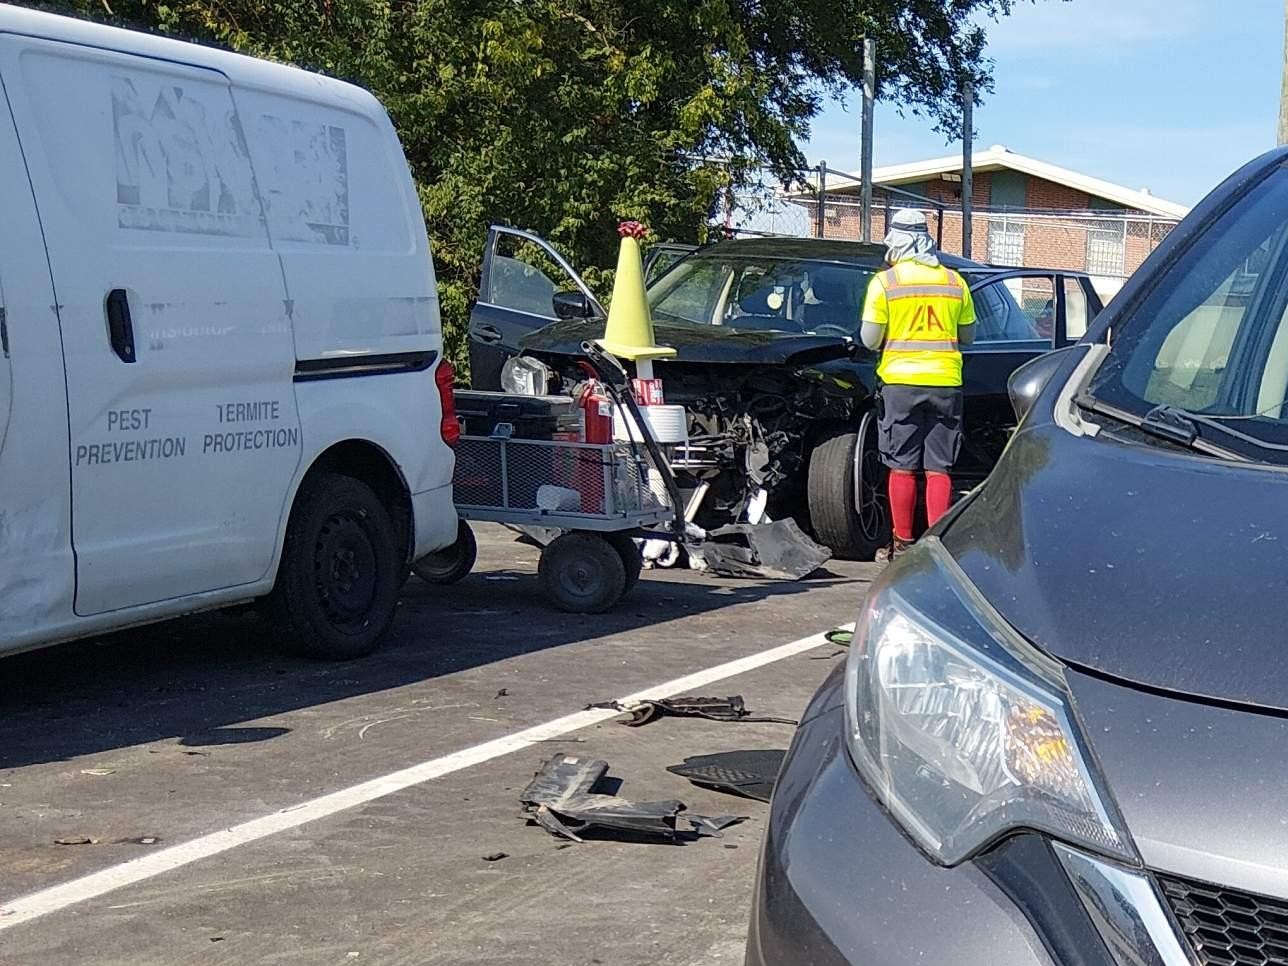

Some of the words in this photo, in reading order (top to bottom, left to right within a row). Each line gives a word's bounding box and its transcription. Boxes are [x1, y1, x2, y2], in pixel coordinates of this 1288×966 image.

[107, 409, 152, 431] PEST
[216, 401, 280, 423] TERMITE
[75, 437, 186, 466] PREVENTION
[203, 428, 298, 454] PROTECTION
